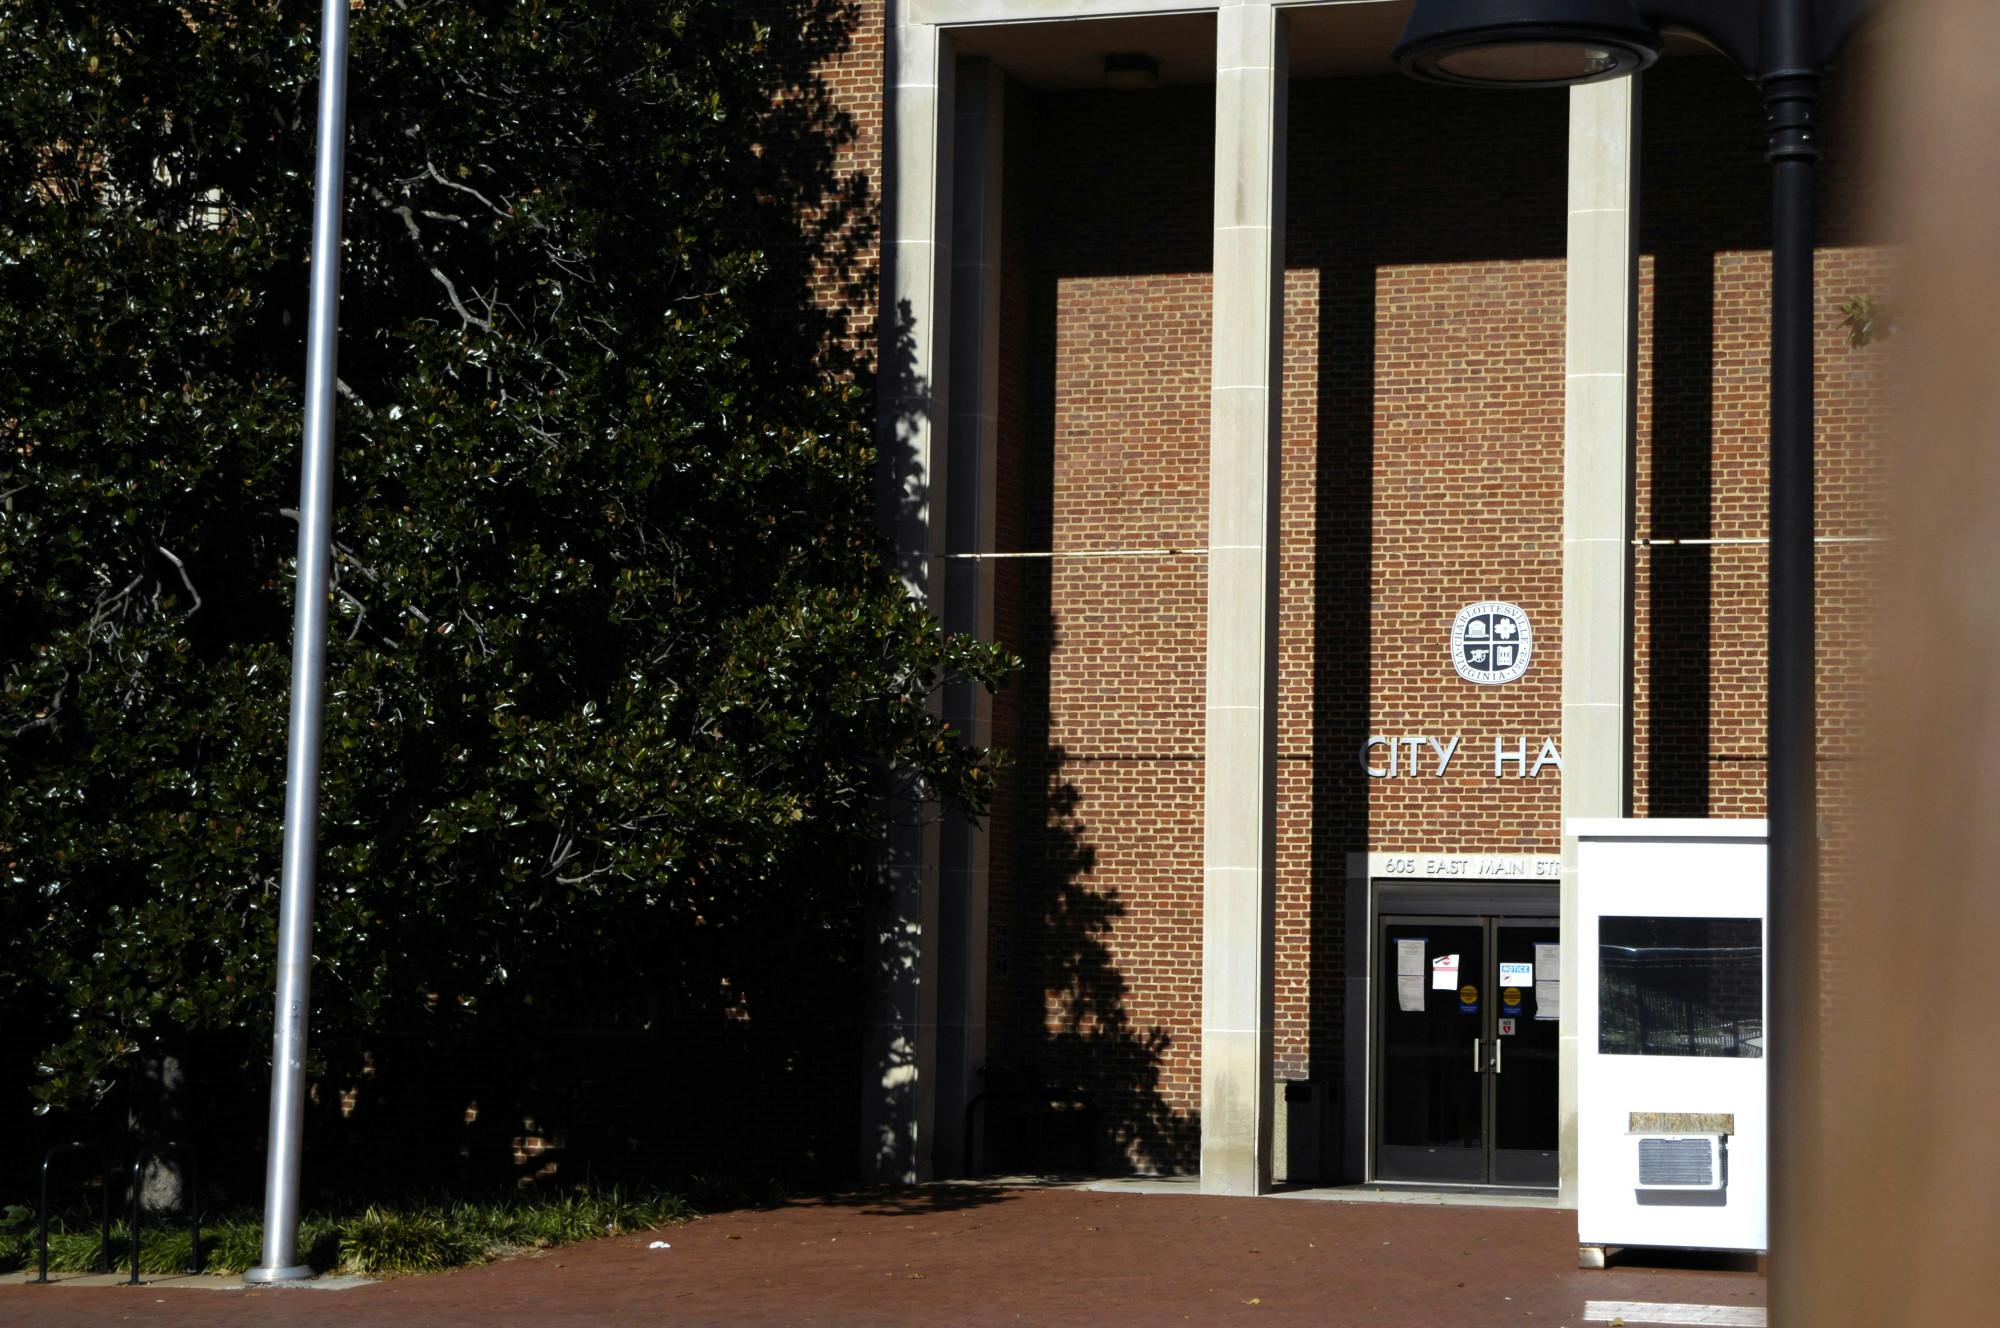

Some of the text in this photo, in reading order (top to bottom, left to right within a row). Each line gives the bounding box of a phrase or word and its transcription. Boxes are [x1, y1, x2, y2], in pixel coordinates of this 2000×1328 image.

[1454, 604, 1529, 647] CHARLOTTESVILLE
[1455, 651, 1506, 681] VIRGINIA
[1359, 736, 1562, 778] CITY HA
[1385, 858, 1560, 876] 605 EAST MAIN STR
